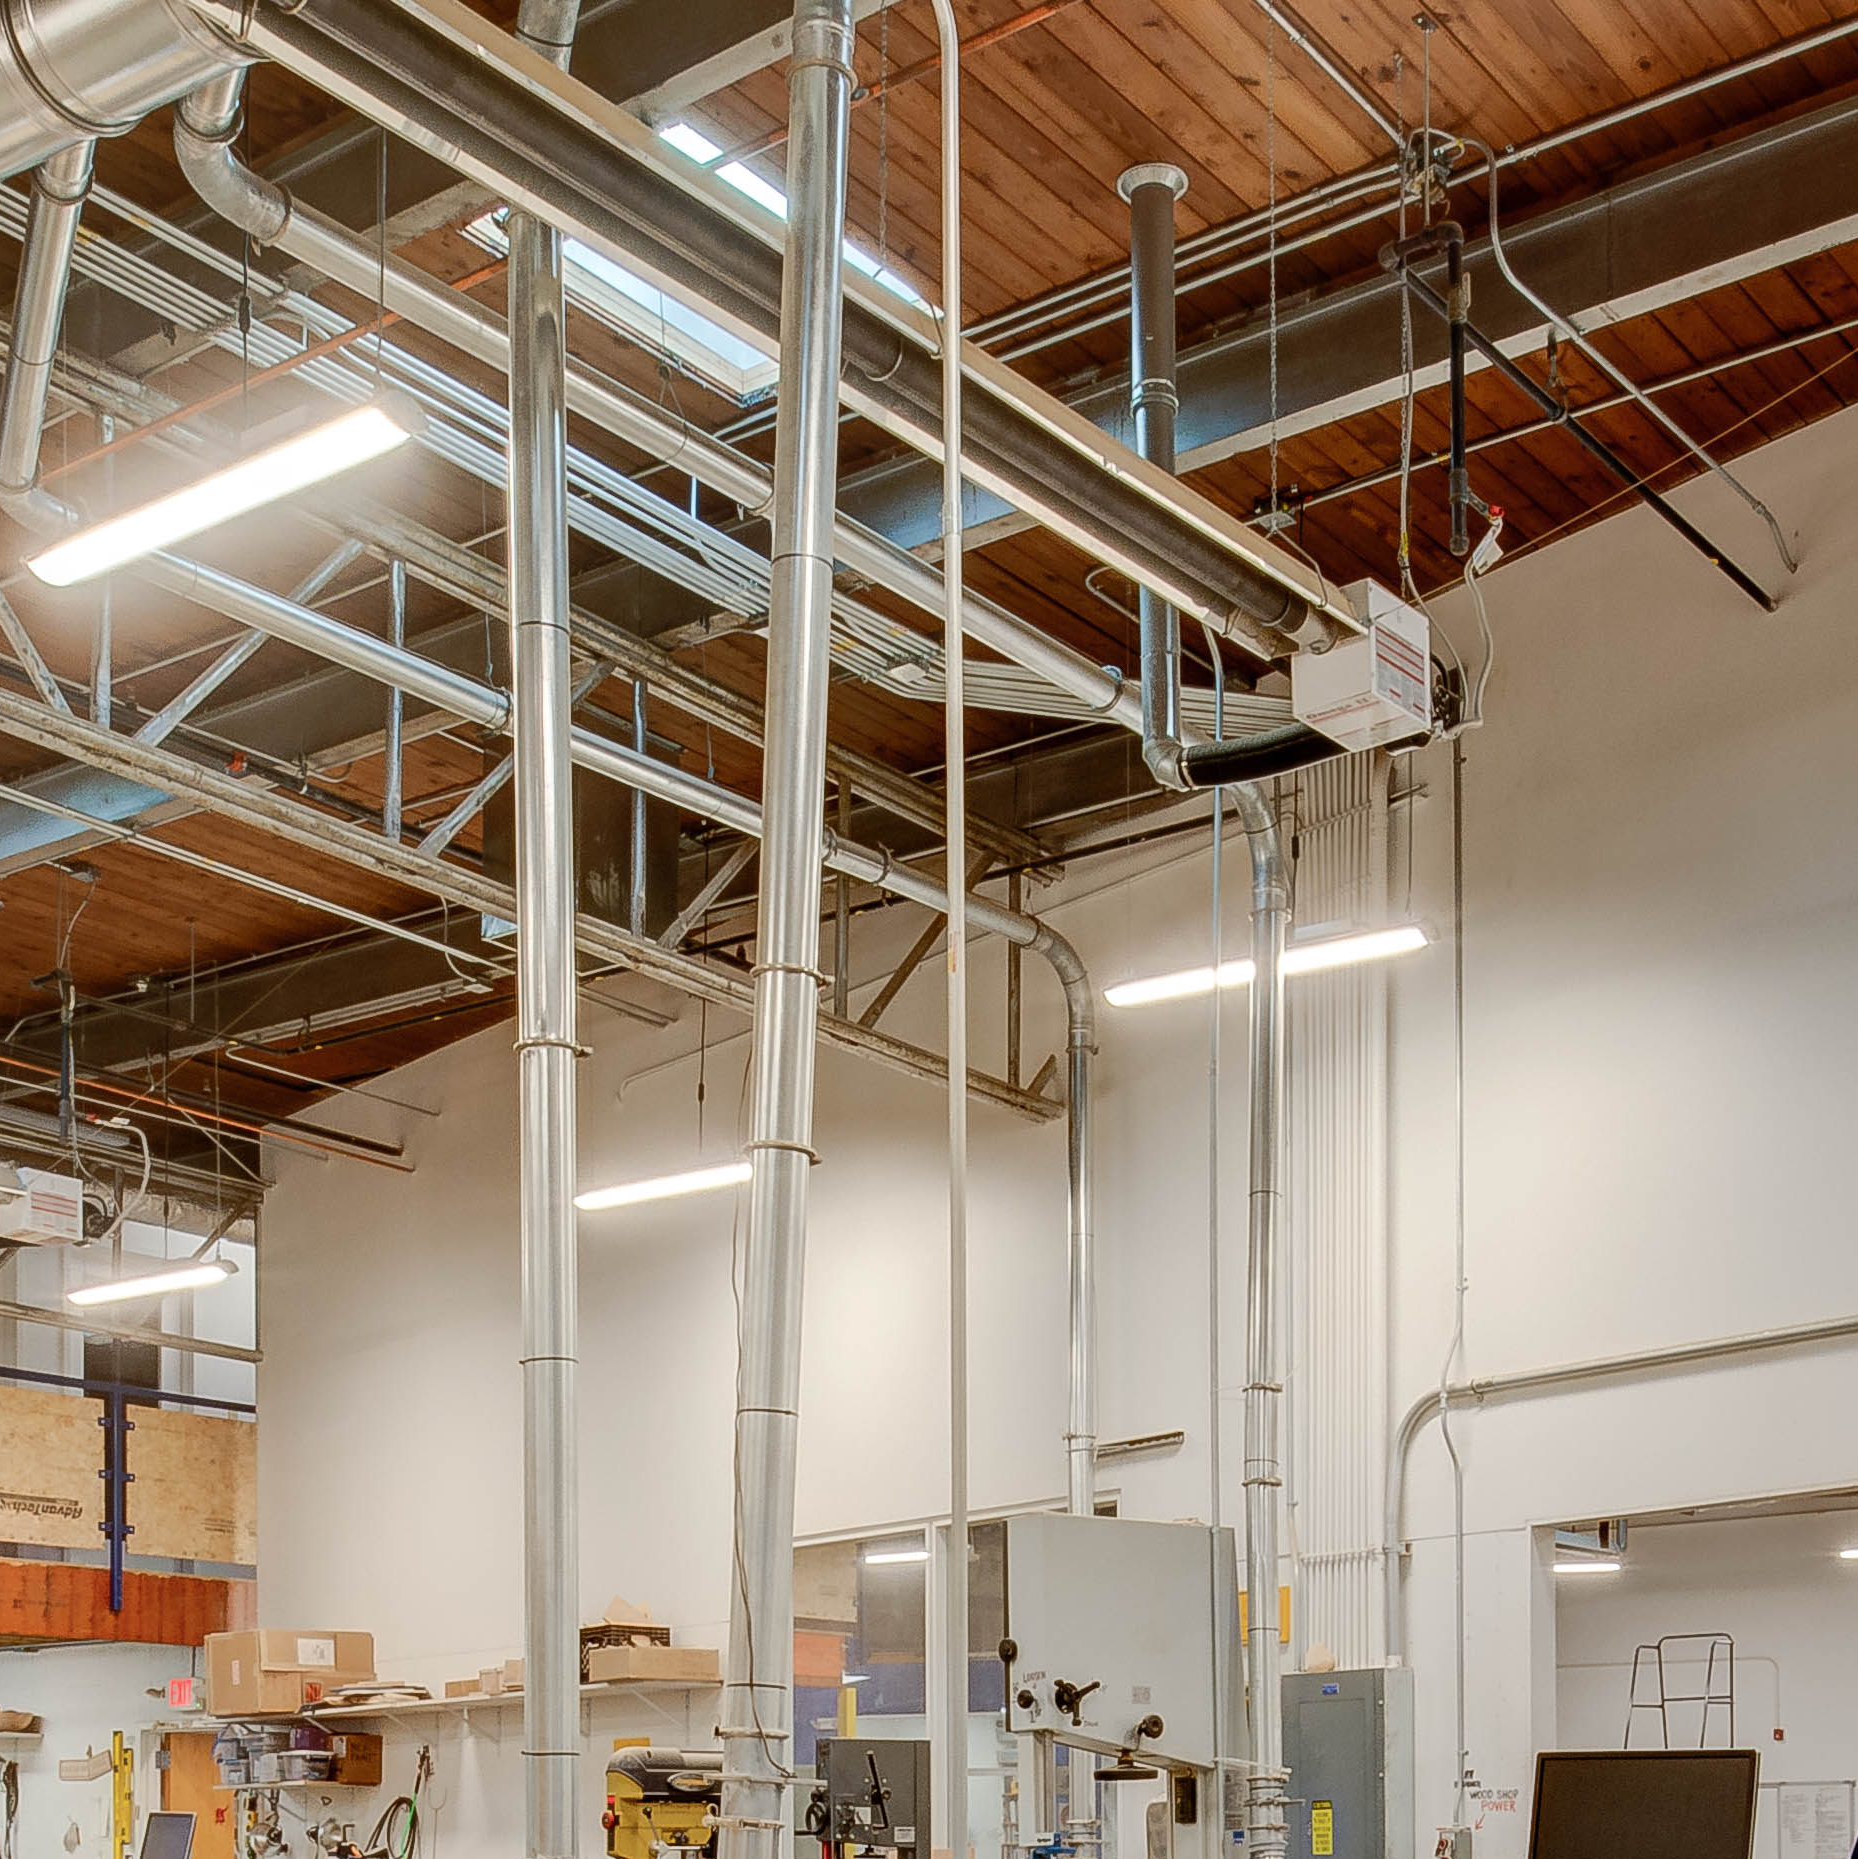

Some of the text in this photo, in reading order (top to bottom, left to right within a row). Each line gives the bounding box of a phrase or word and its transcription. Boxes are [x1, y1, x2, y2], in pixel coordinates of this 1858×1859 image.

[169, 1678, 192, 1707] EXIT
[1497, 1789, 1519, 1799] SHOP
[1480, 1800, 1517, 1813] POWER
